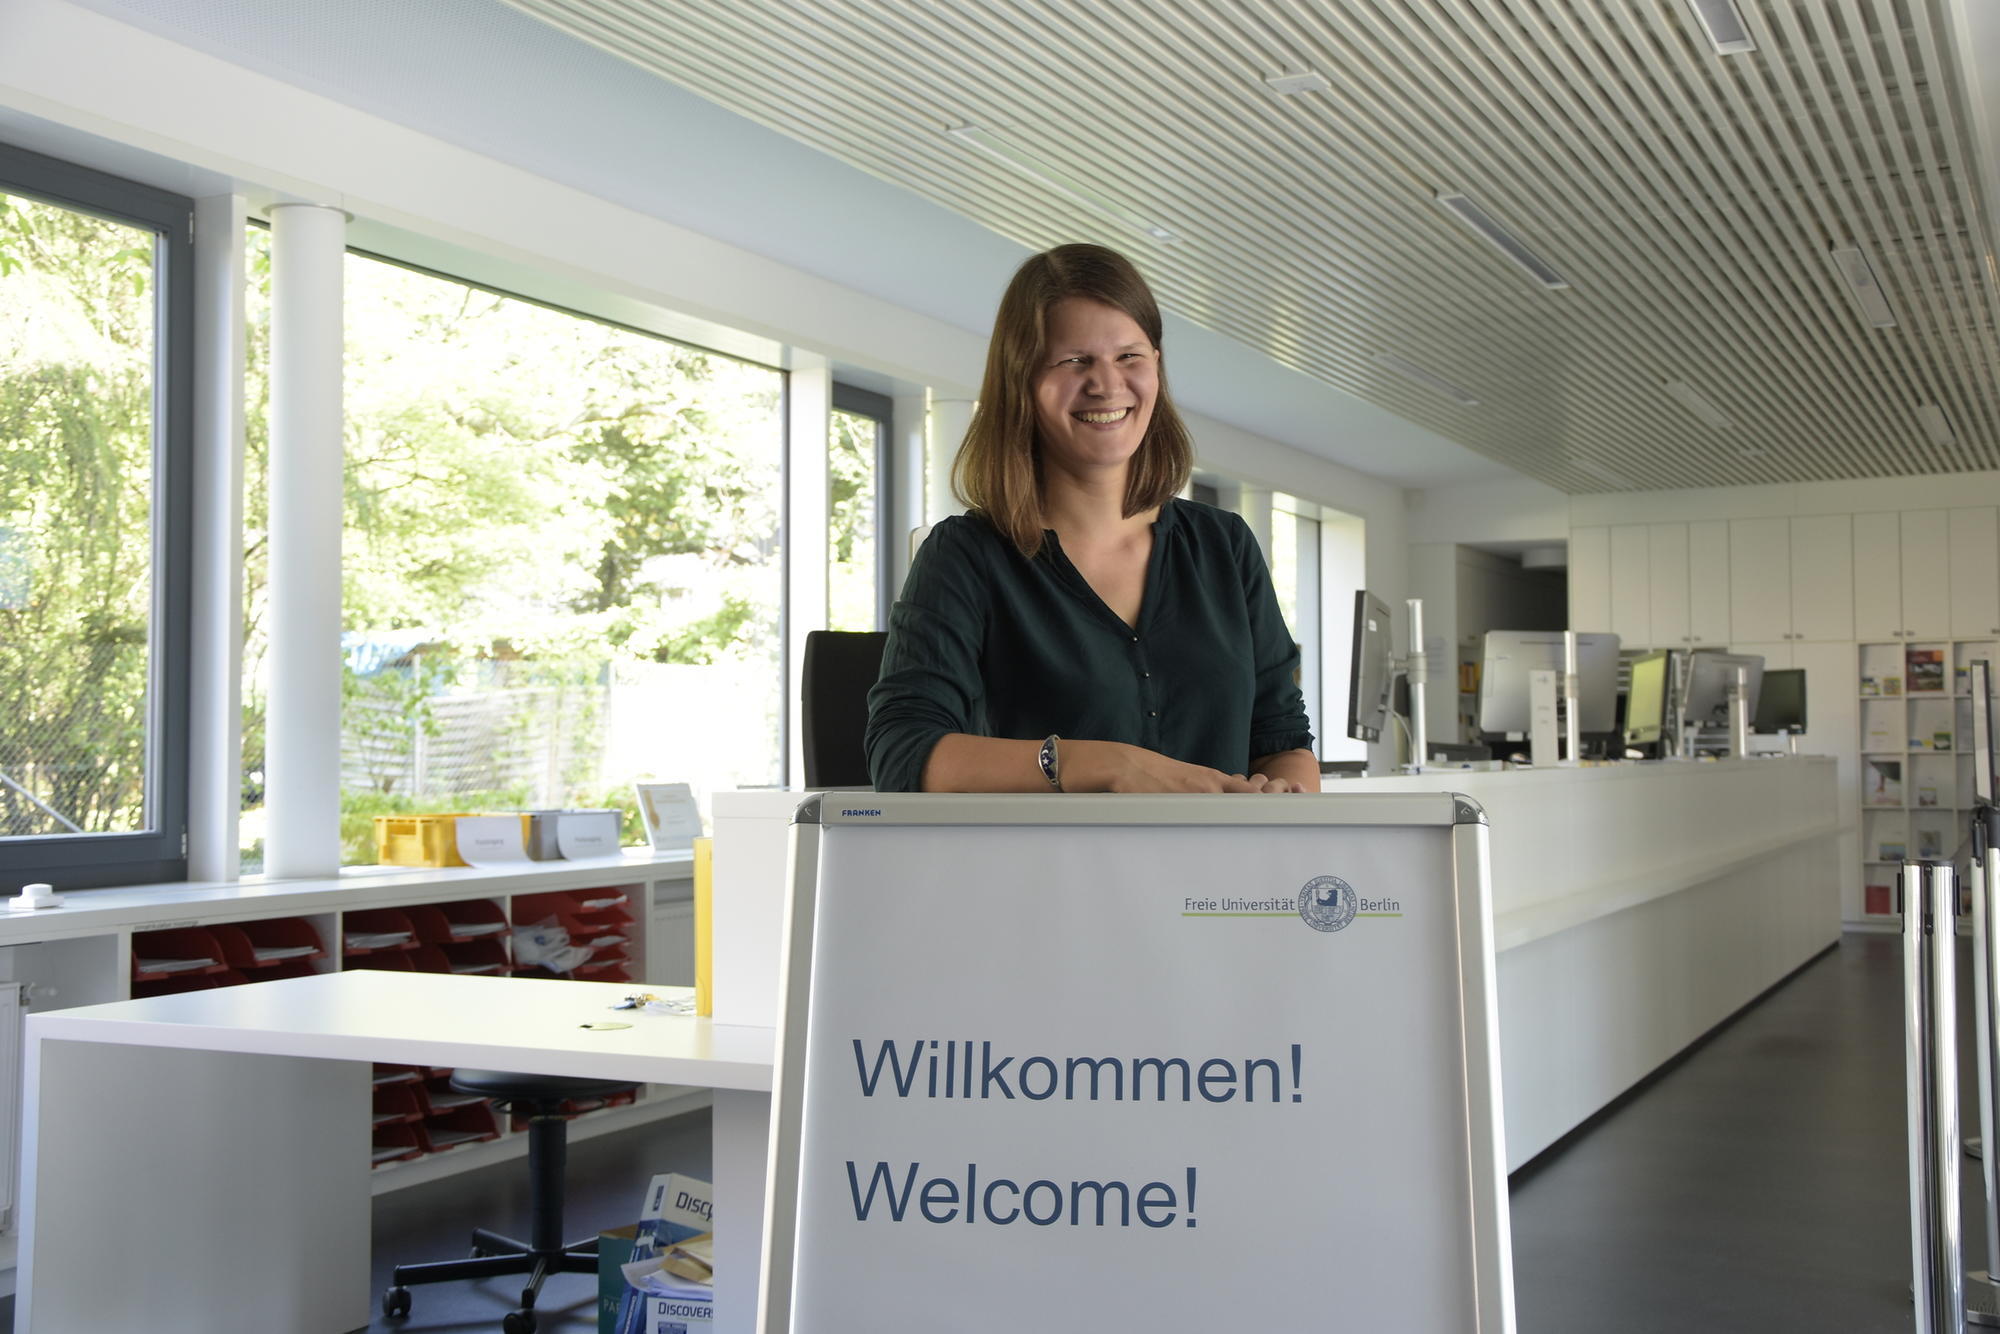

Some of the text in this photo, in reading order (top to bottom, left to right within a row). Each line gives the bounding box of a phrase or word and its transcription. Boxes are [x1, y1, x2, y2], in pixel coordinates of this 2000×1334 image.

[841, 809, 882, 817] FRANKEN
[1185, 898, 1400, 911] Freie Universität Berlin
[852, 1038, 1302, 1104] Willkommen!
[846, 1160, 1197, 1229] Welcome!
